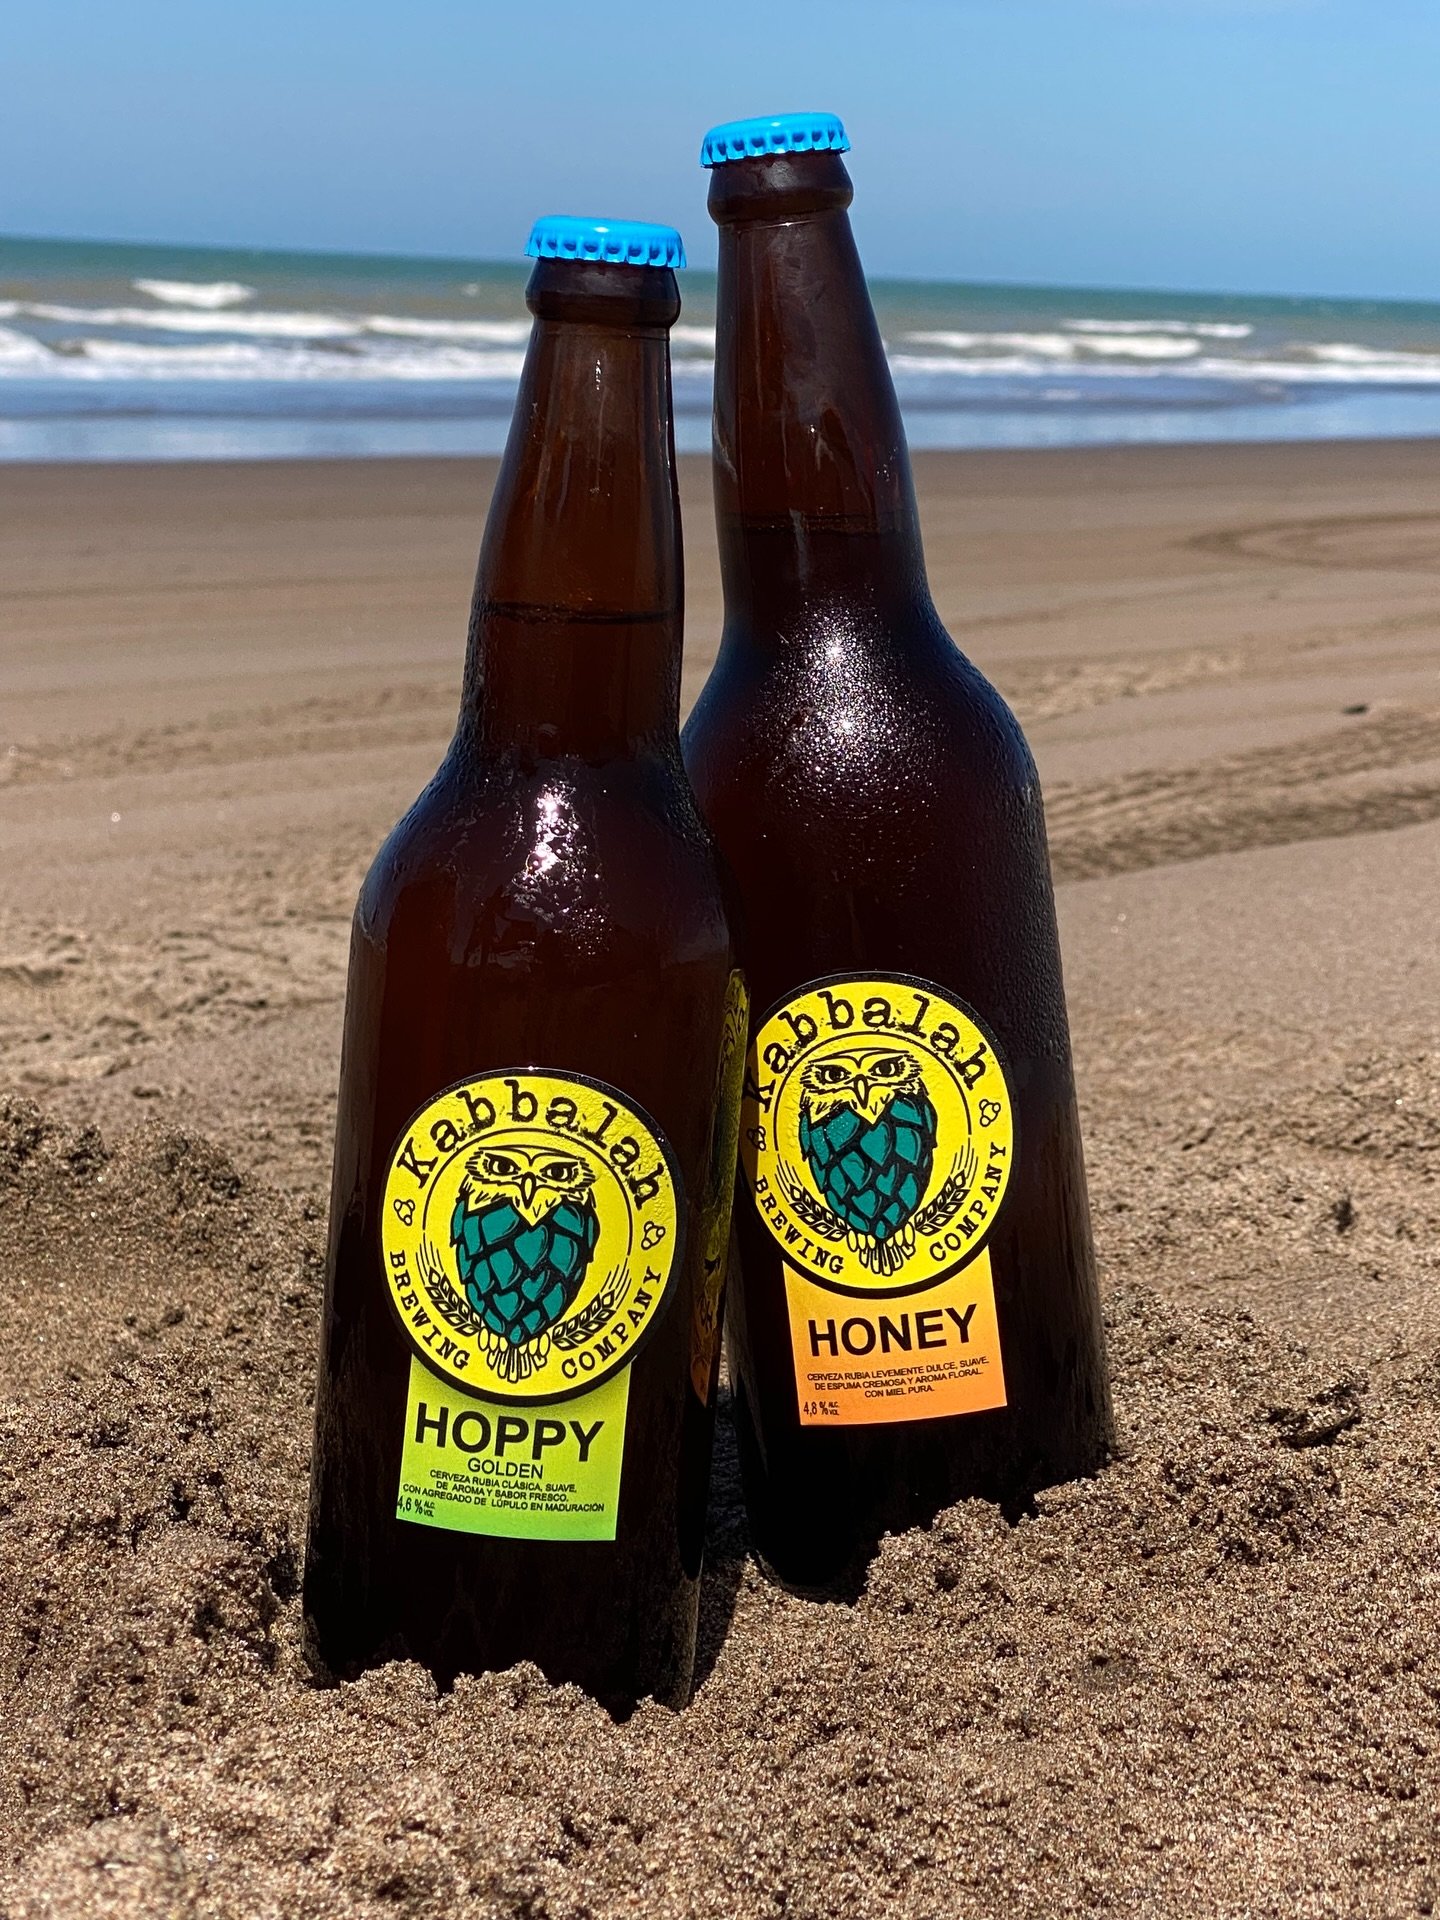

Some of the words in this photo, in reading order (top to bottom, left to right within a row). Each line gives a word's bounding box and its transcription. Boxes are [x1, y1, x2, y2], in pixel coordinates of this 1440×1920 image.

[742, 990, 988, 1113] Kabbalah
[396, 1079, 666, 1211] Kabbalah
[754, 1175, 845, 1274] BREWING
[930, 1142, 1006, 1262] COMPANY
[390, 1250, 471, 1372] BREWING
[562, 1266, 662, 1379] COMPANY
[808, 1303, 977, 1357] HONEY
[807, 1373, 843, 1381] CERVEZA
[845, 1372, 870, 1380] RUBIA
[872, 1365, 924, 1379] LEVEMENTE
[827, 1381, 861, 1390] ESPUMA
[863, 1378, 906, 1388] CREMOSA
[915, 1373, 947, 1383] AROMA
[865, 1390, 883, 1398] CON
[886, 1387, 906, 1396] MIEL
[803, 1401, 817, 1418] 4,8
[415, 1402, 605, 1462] HOPPY
[430, 1469, 470, 1484] CERVEZA
[473, 1476, 500, 1488] RUBIA
[467, 1457, 544, 1480] GOLDEN
[403, 1483, 421, 1494] CON
[422, 1487, 472, 1503] AGREGADO
[474, 1496, 486, 1505] DE
[530, 1503, 543, 1511] EN
[545, 1502, 604, 1512] MADURACIÓN
[436, 1481, 448, 1490] DE
[452, 1483, 484, 1496] AROMA
[495, 1489, 526, 1500] SABOR
[529, 1492, 569, 1502] FRESCO.
[397, 1495, 412, 1512] 4,6
